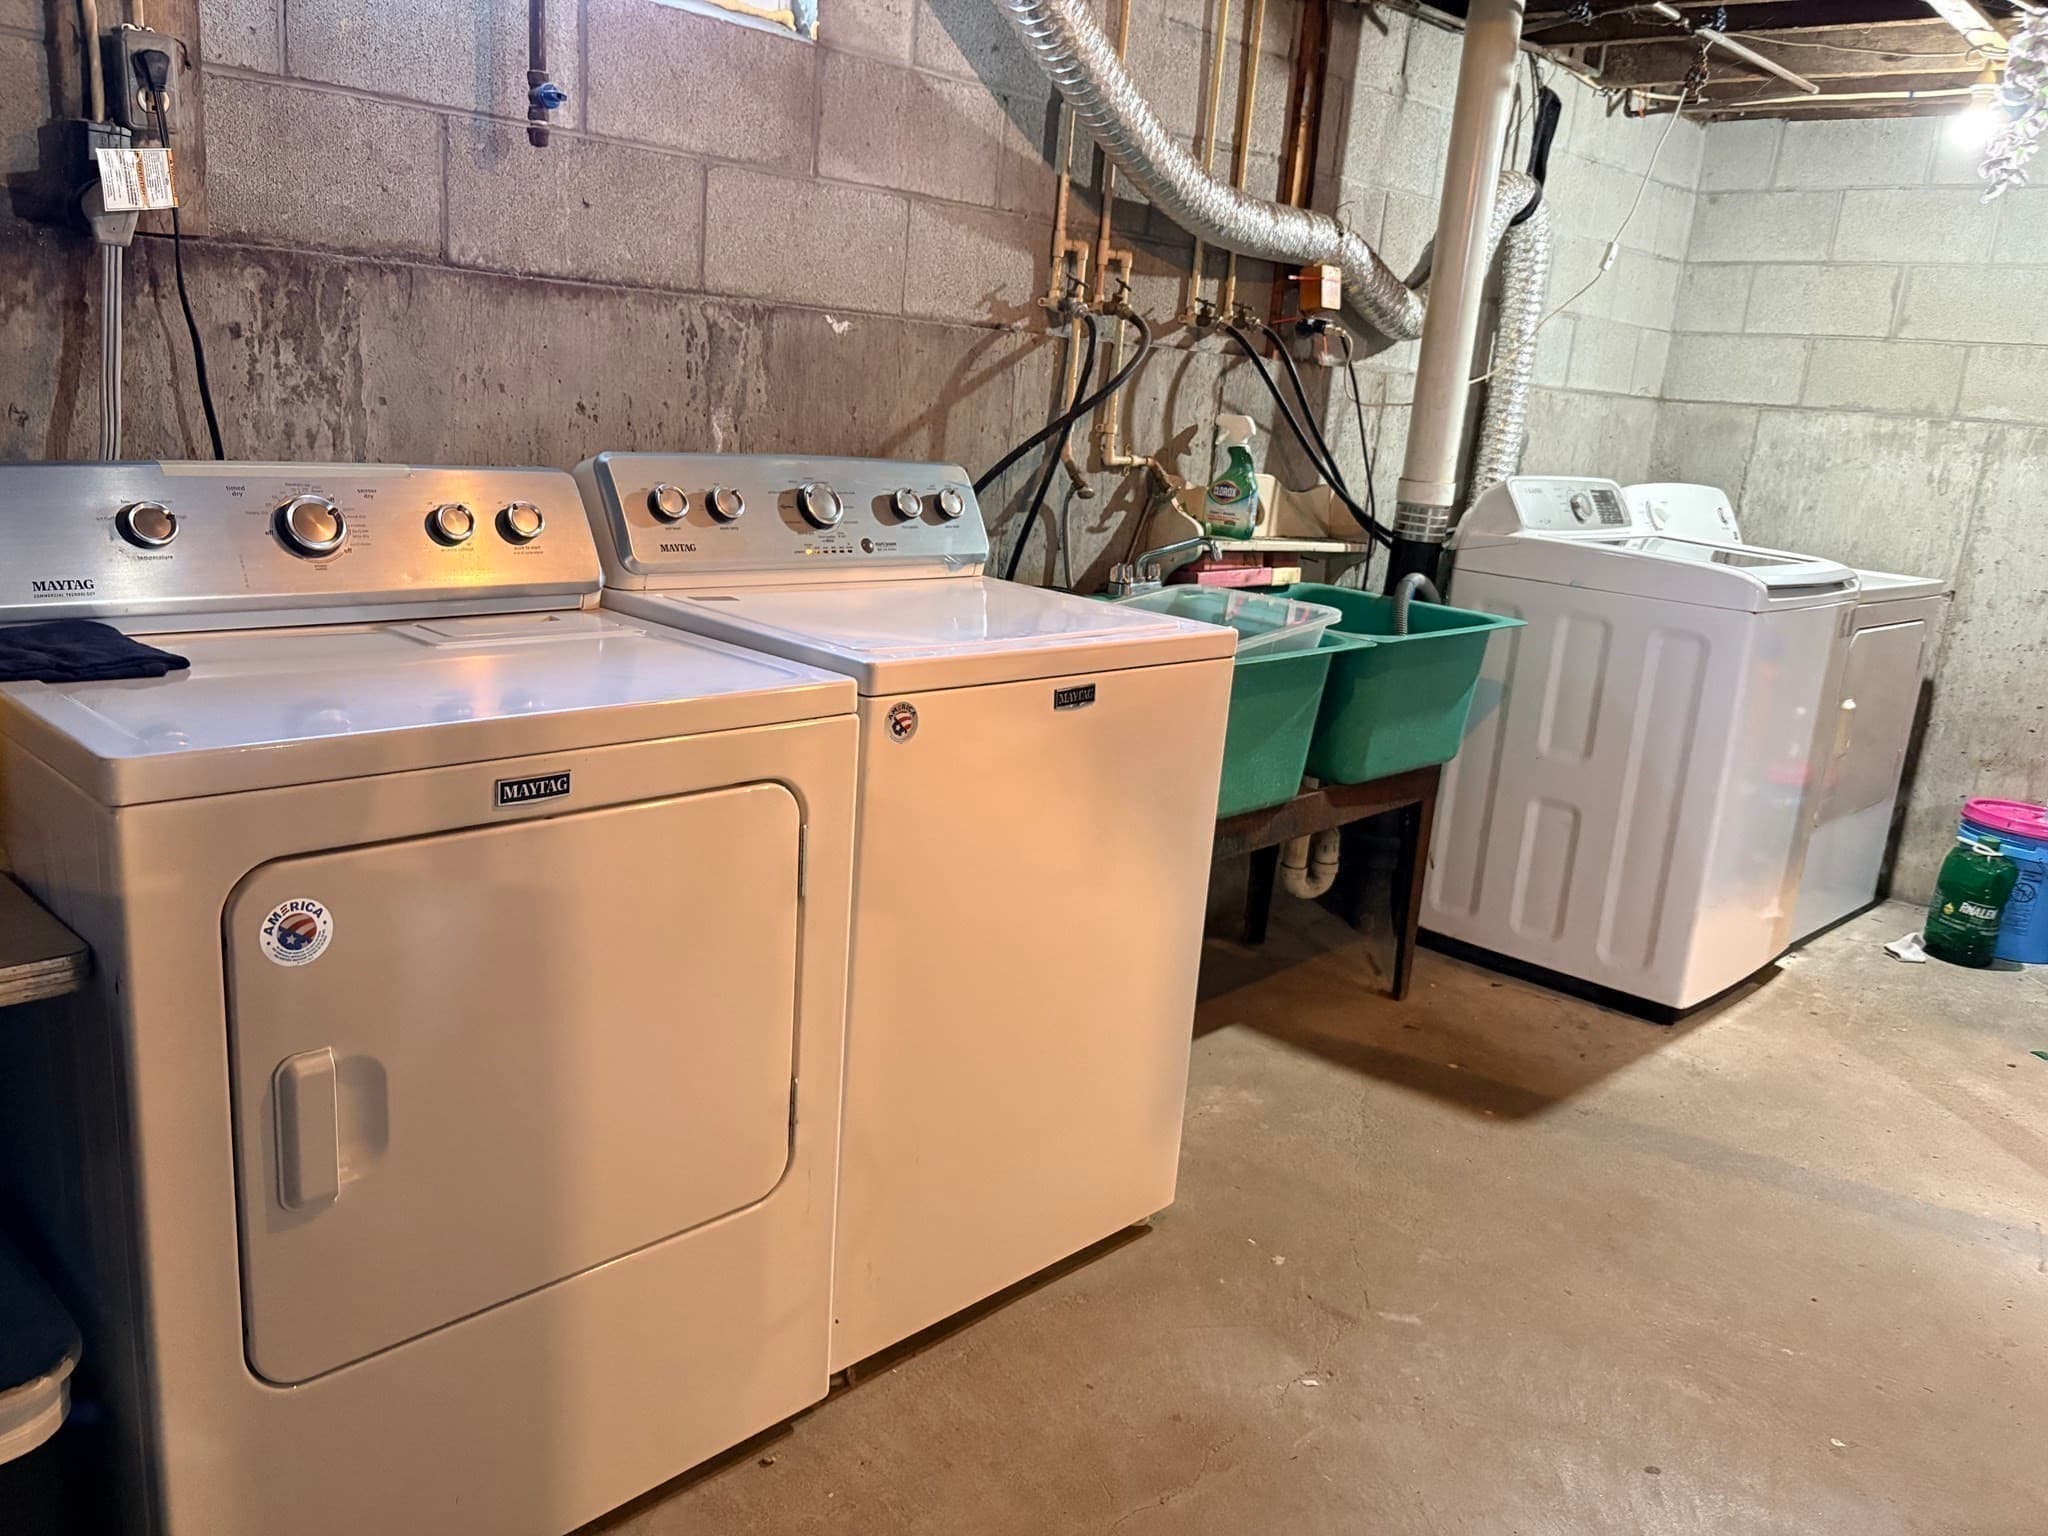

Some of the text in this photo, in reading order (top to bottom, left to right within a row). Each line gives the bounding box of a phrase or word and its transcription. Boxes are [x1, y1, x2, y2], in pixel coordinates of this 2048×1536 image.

[1213, 486, 1237, 497] CLOROX
[660, 543, 697, 553] MAYTAG
[32, 578, 95, 592] MAYTAG
[1057, 687, 1094, 705] MAYTAG
[888, 703, 916, 721] AMERICA
[503, 777, 568, 800] MAYTAG
[263, 900, 324, 937] AMERICA
